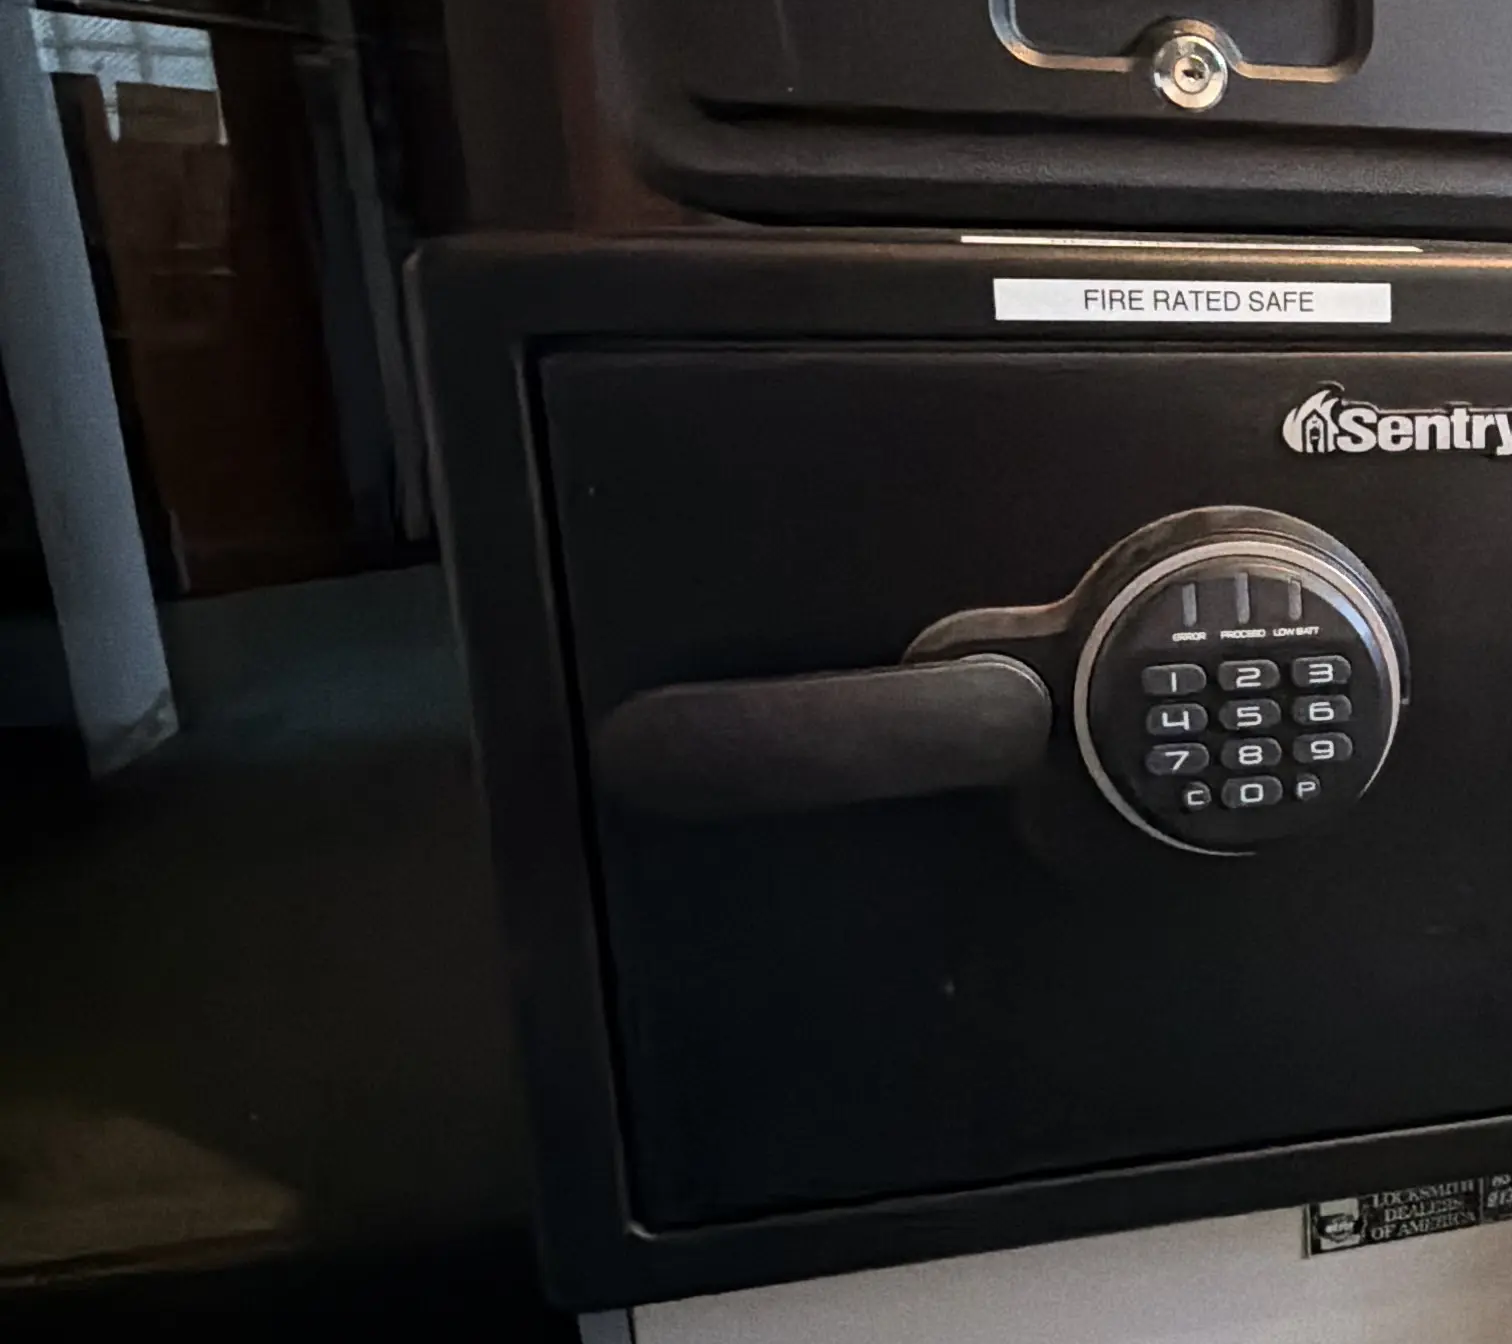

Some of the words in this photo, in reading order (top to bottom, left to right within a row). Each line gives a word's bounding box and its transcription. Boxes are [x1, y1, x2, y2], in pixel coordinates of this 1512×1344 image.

[1084, 289, 1144, 311] FIRE
[1154, 290, 1240, 312] RATED
[1248, 291, 1314, 313] SAFE
[1170, 672, 1177, 692] 1
[1236, 667, 1261, 689] 2
[1308, 663, 1333, 684] 3
[1162, 710, 1190, 731] 4
[1236, 706, 1262, 728] 5
[1309, 701, 1334, 722] 6
[1165, 750, 1190, 773] 7
[1238, 745, 1263, 765] 8
[1310, 740, 1334, 760] 9
[1187, 789, 1204, 806] C
[1240, 783, 1264, 803] 0
[1297, 781, 1316, 797] P
[1371, 1223, 1396, 1241] OF
